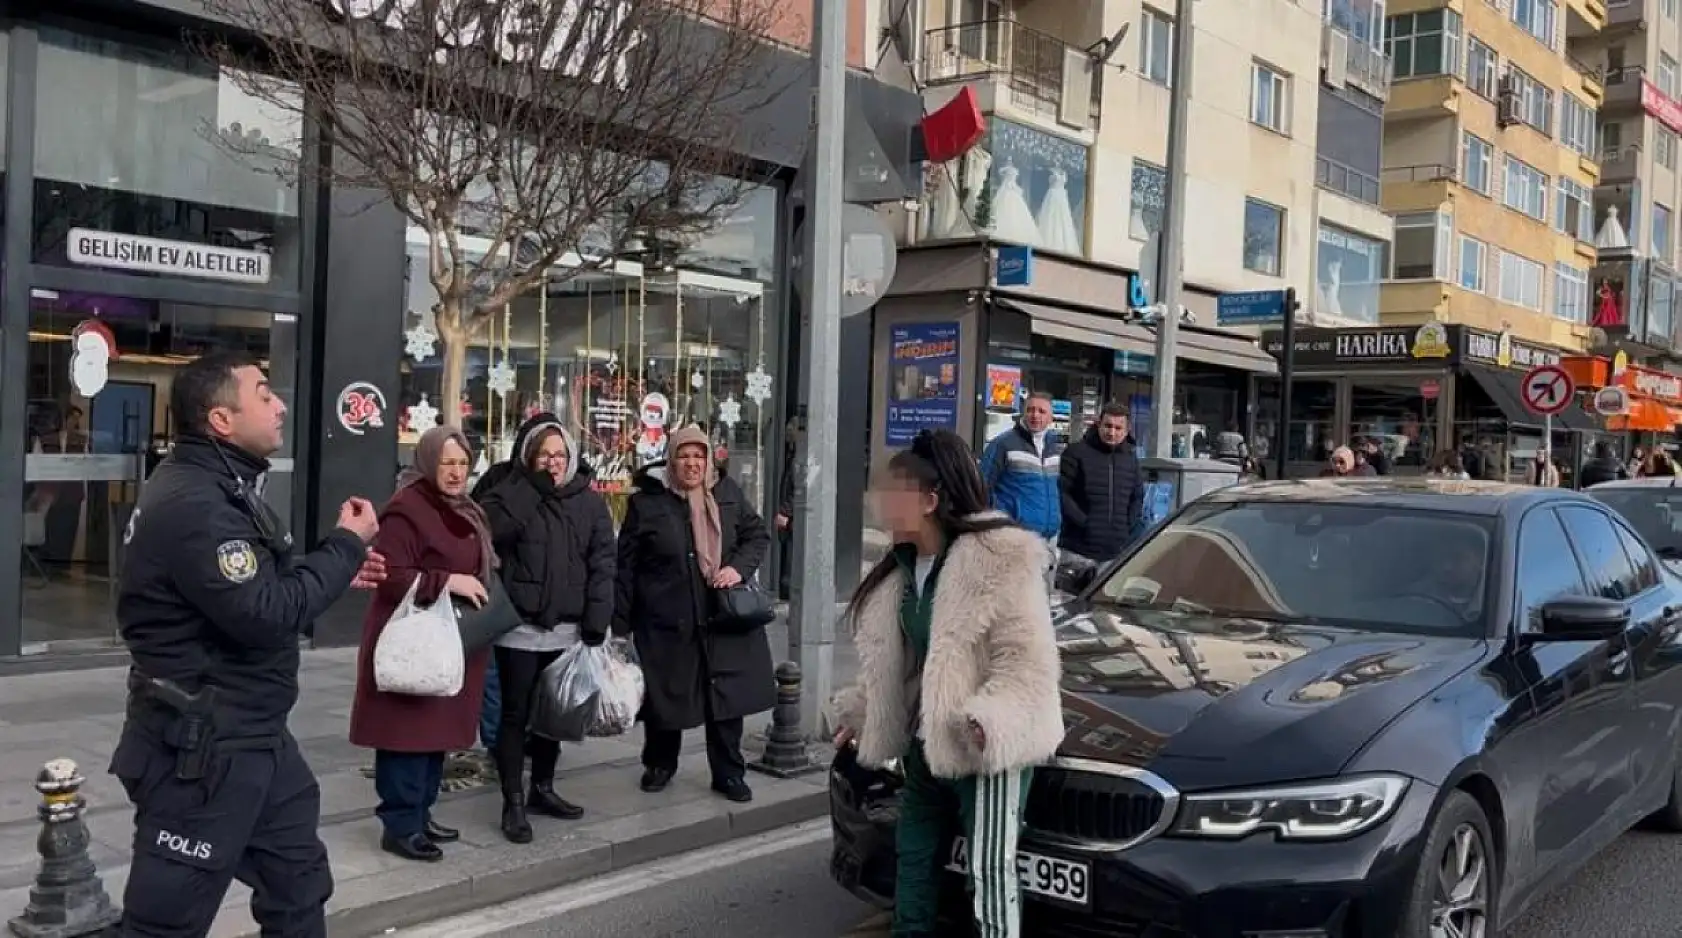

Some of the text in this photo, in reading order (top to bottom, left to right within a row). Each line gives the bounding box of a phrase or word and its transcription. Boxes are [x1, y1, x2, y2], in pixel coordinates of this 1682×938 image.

[78, 237, 262, 276] GELİŞİM EV ALETLERİ
[155, 829, 213, 860] POLİS
[1037, 859, 1086, 898] 959
